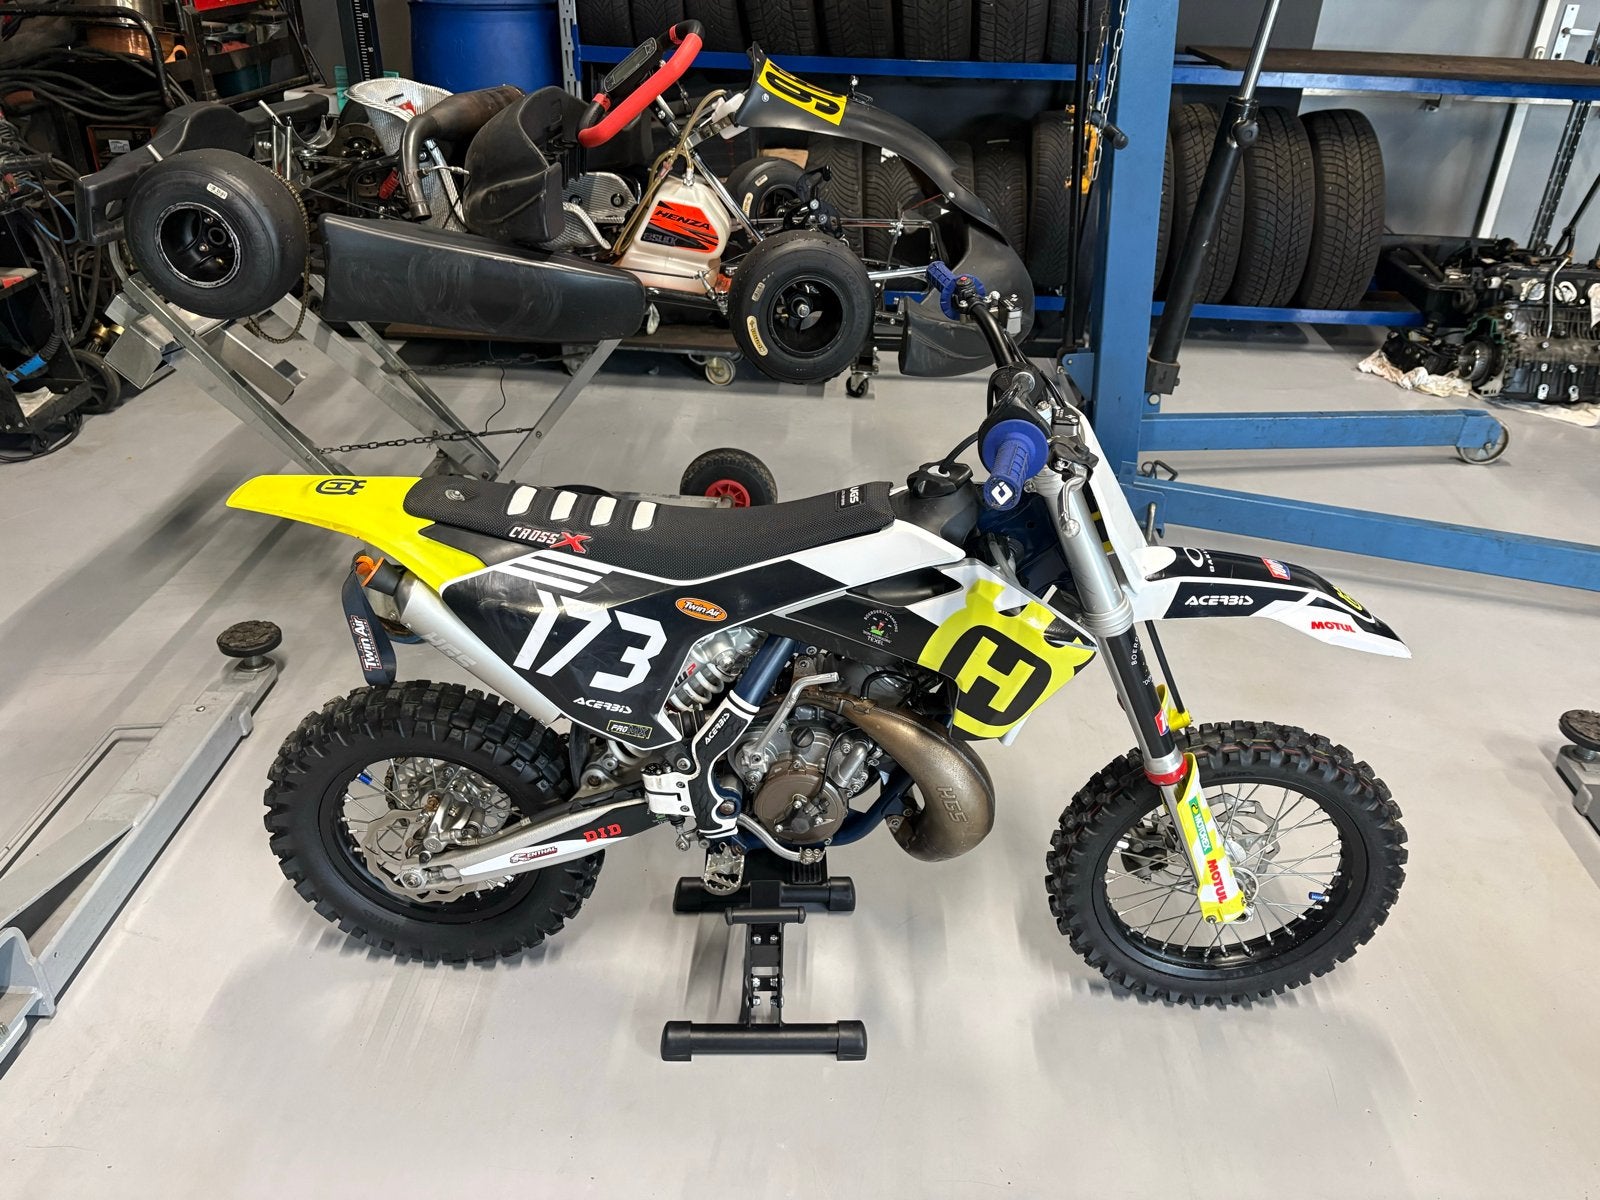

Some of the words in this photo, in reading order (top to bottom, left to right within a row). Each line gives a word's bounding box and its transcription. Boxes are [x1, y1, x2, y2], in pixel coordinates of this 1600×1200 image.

[655, 210, 710, 230] HENZA
[684, 600, 705, 613] Twin
[705, 608, 721, 618] Air
[1185, 595, 1254, 606] ACERBIS
[353, 617, 369, 638] Air
[1311, 621, 1356, 633] MOTUL
[512, 588, 668, 693] 173
[361, 638, 378, 670] Twin
[573, 697, 632, 715] ACERBIS
[705, 712, 730, 745] ACERBIS
[936, 786, 968, 823] HGS
[1194, 813, 1211, 852] MOTOREX
[1207, 858, 1228, 904] MOTUL
